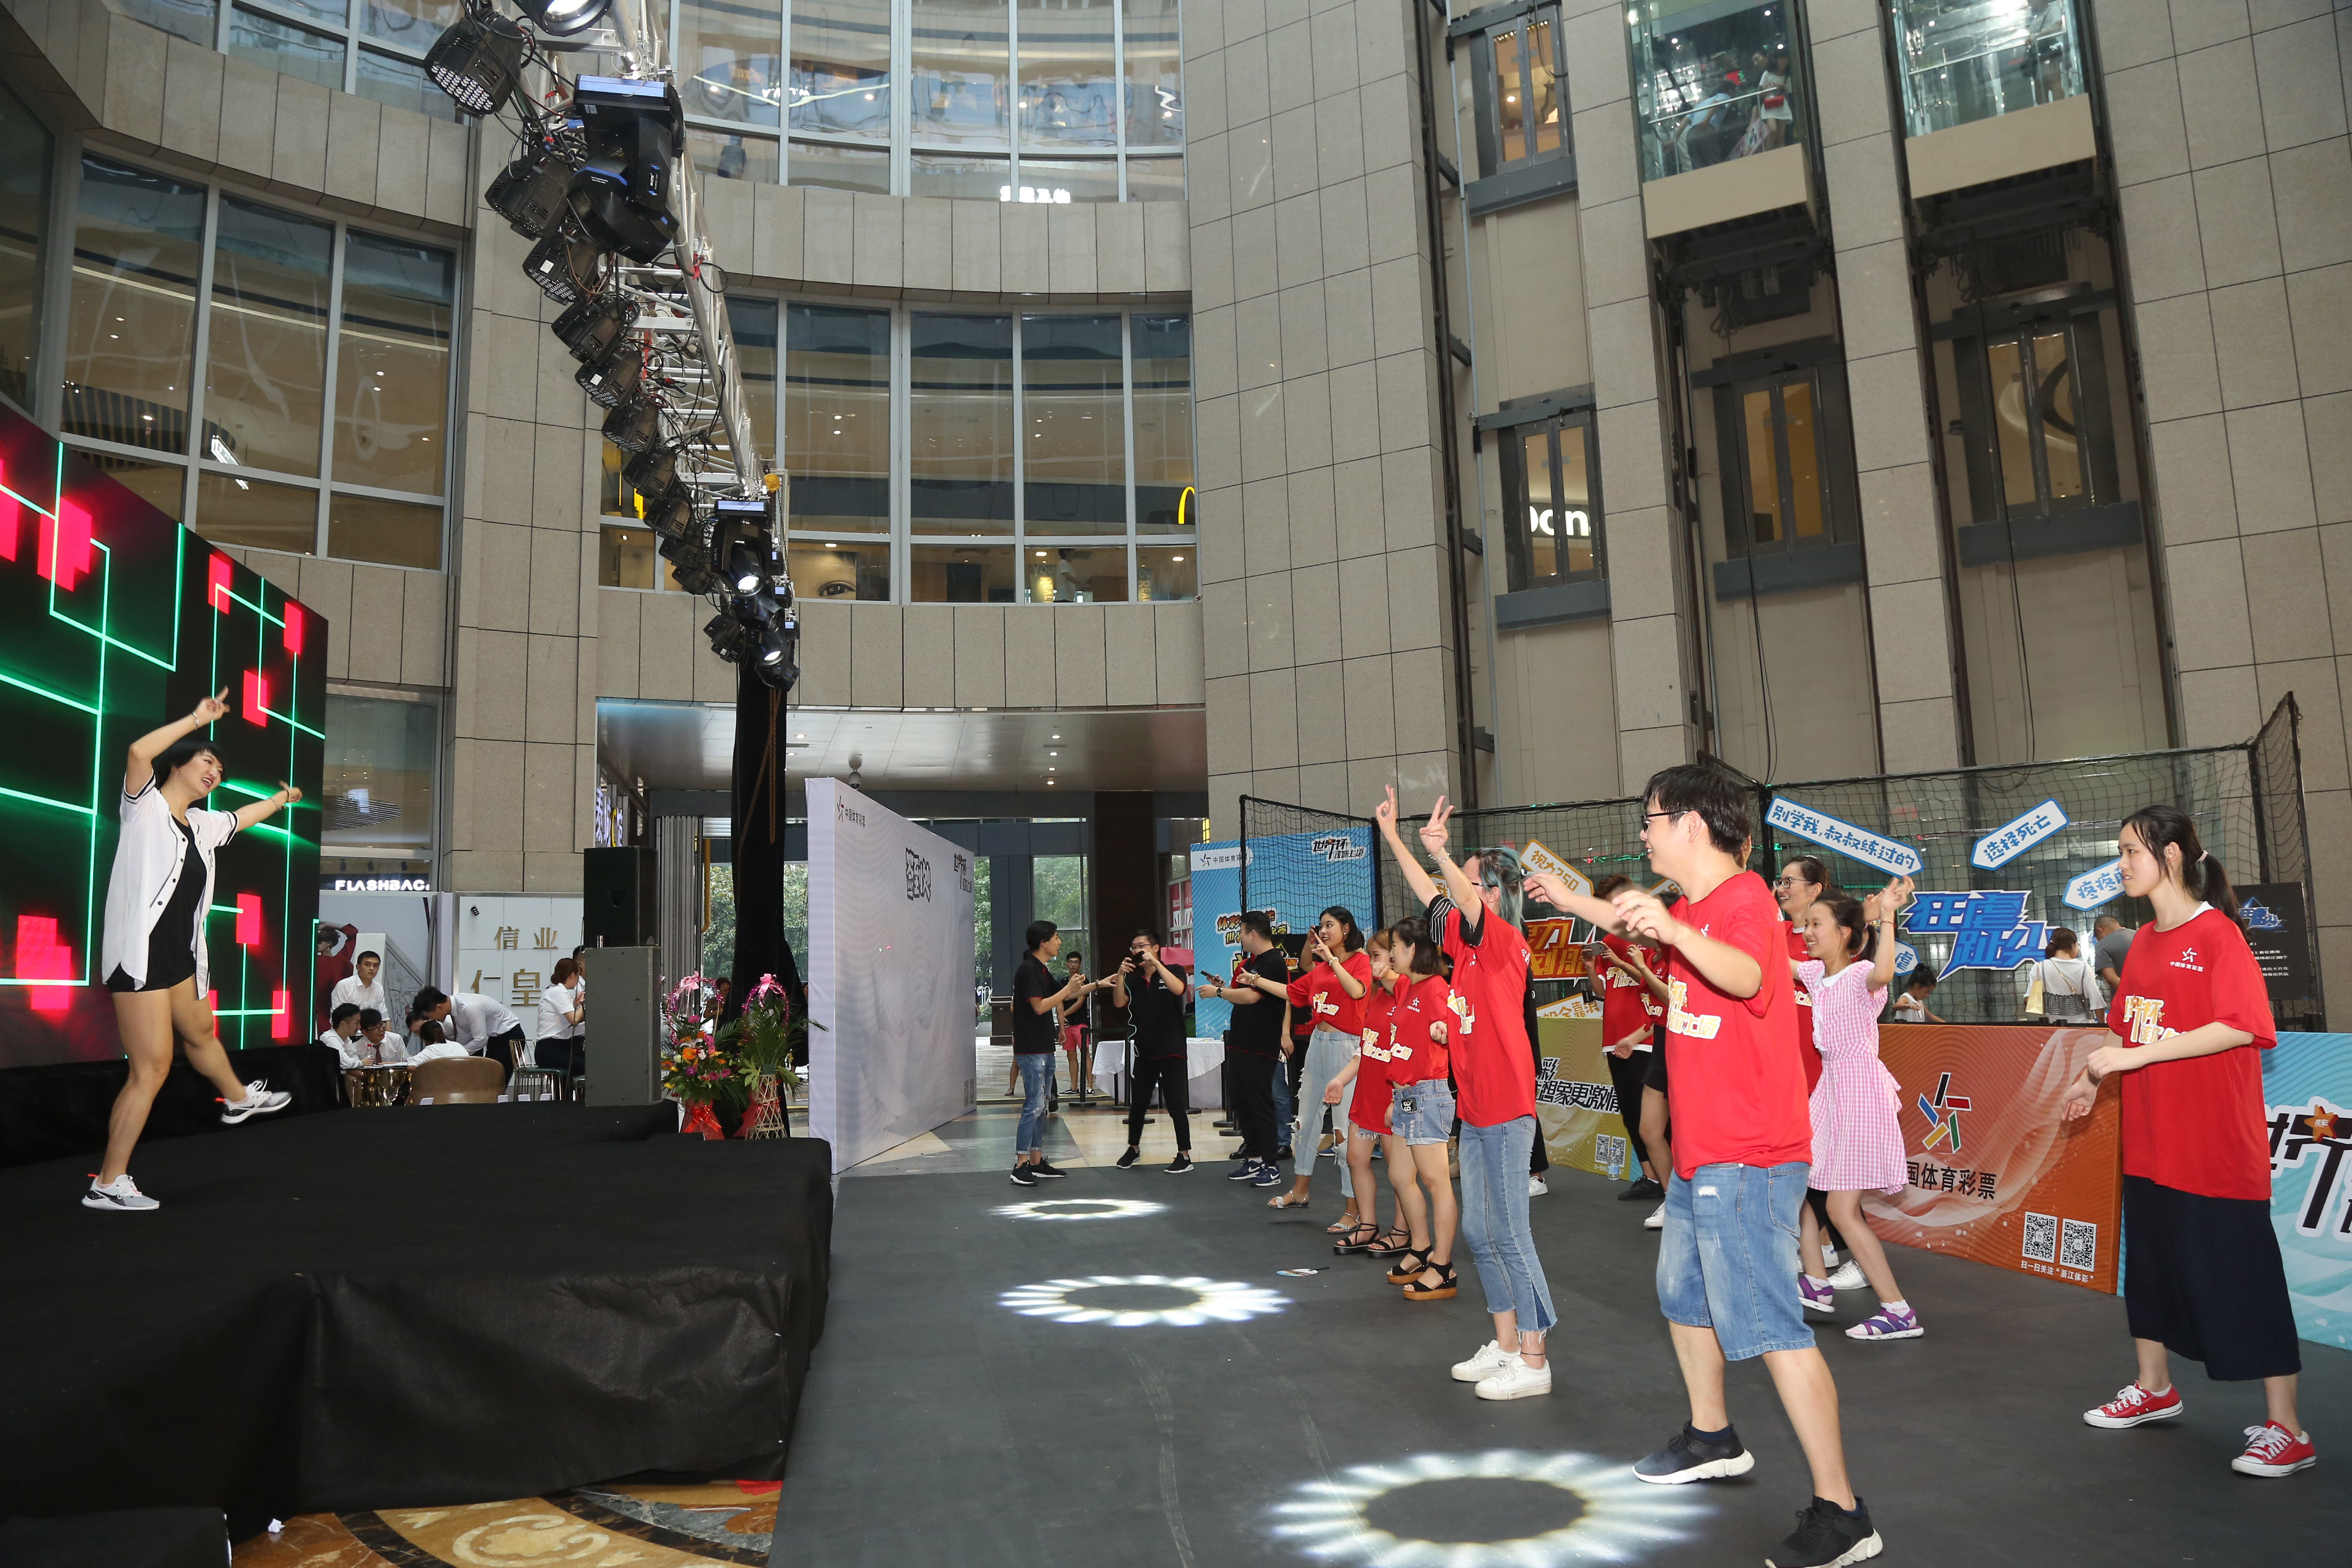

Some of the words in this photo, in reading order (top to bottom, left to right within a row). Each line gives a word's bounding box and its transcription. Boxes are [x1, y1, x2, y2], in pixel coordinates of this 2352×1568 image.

[1983, 815, 2051, 862] 选择死亡
[1910, 894, 2022, 930] 狂虐
[494, 926, 558, 949] 信业
[2169, 961, 2204, 972] 中国体育彩票
[1536, 1080, 1620, 1112] 想象更激情
